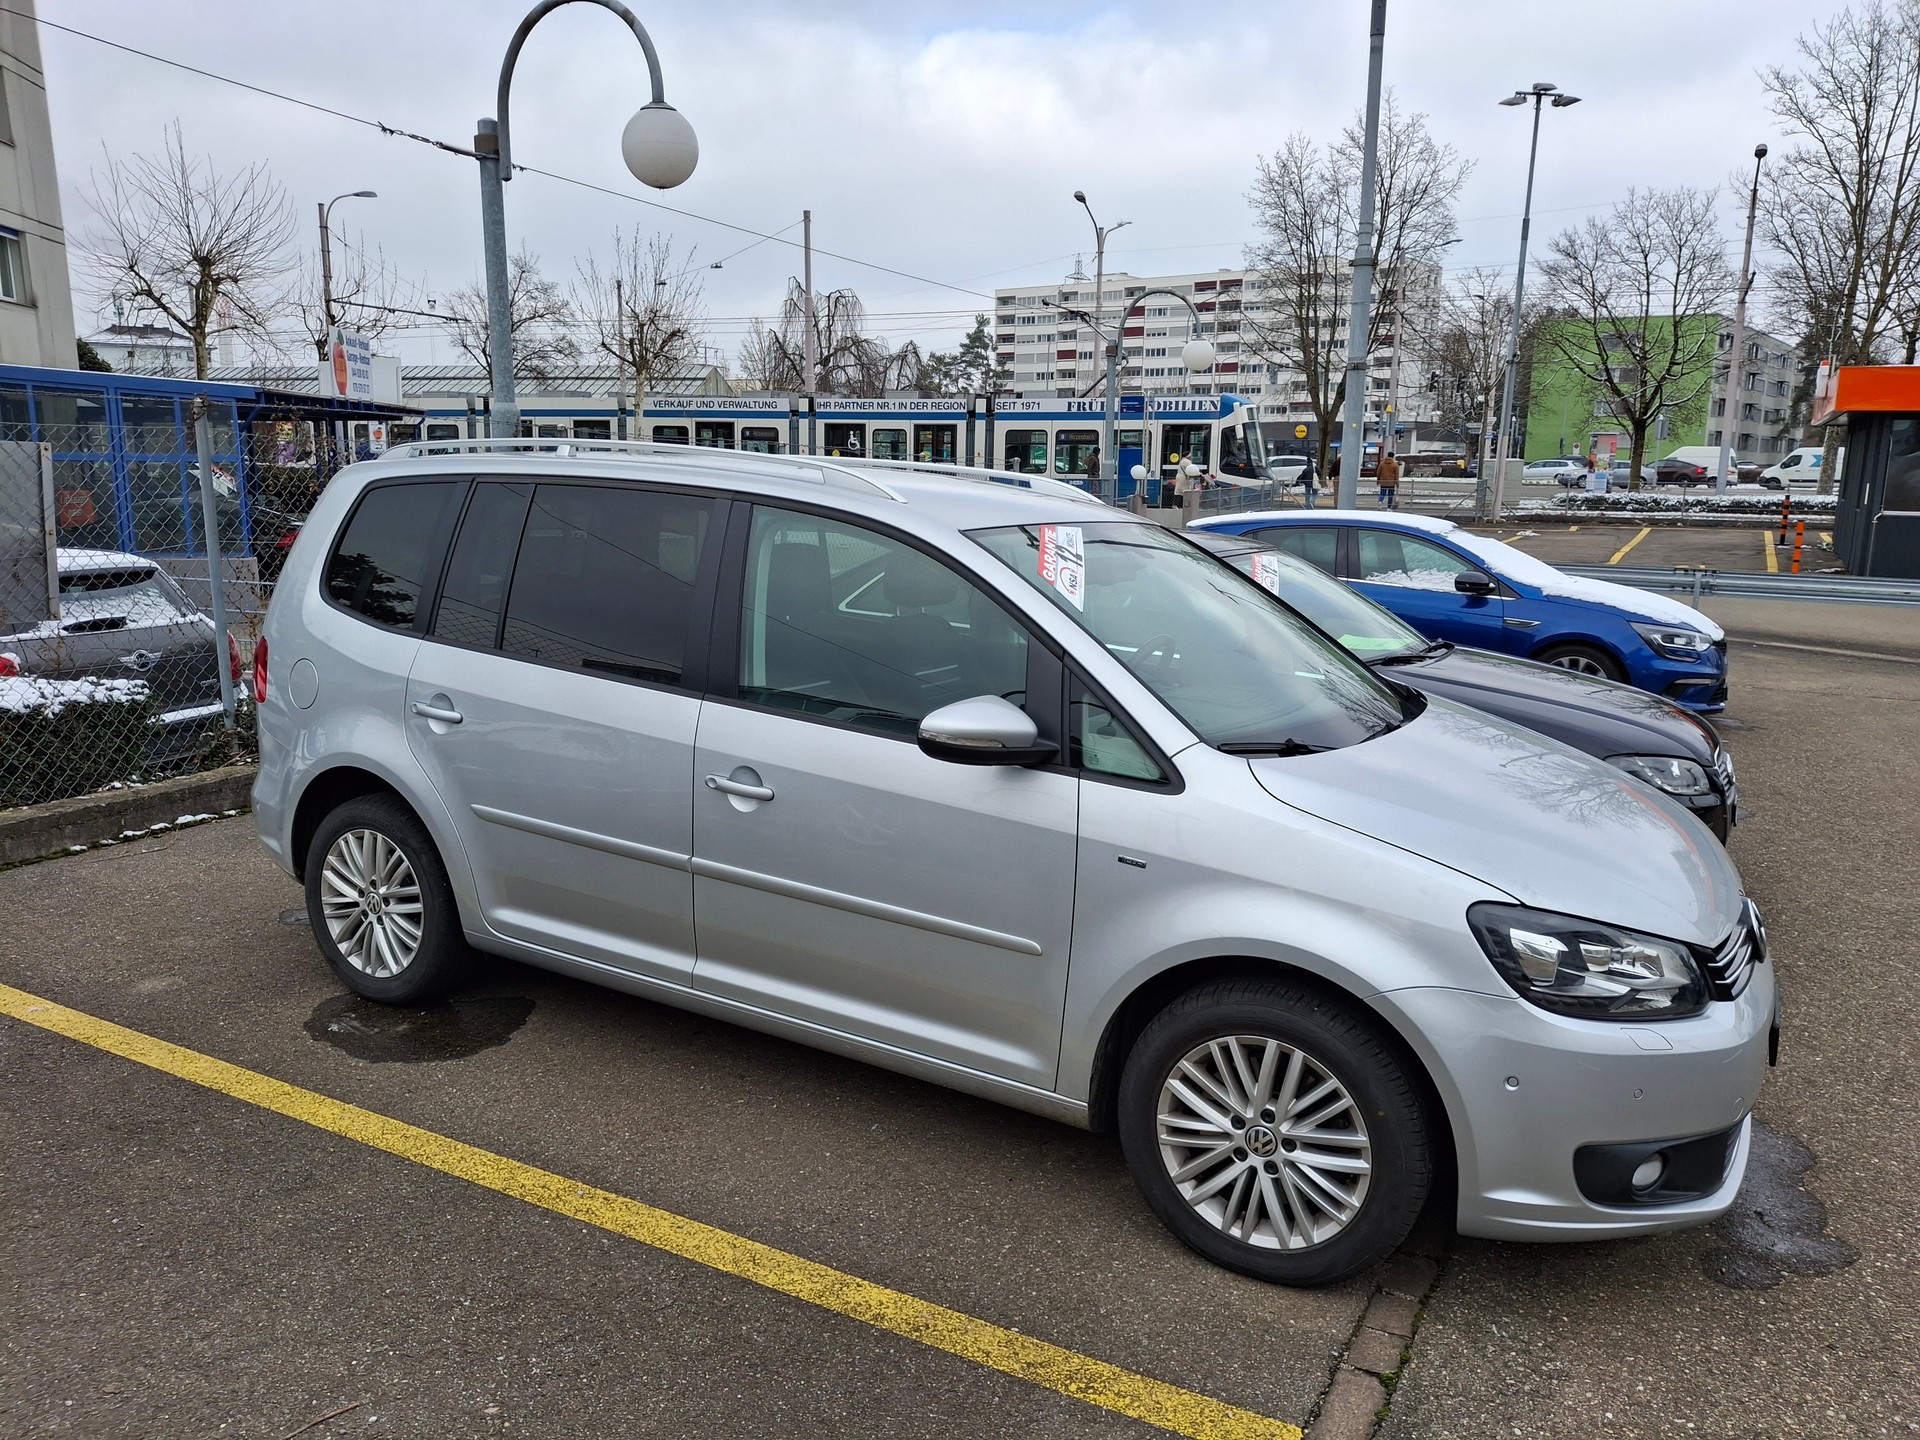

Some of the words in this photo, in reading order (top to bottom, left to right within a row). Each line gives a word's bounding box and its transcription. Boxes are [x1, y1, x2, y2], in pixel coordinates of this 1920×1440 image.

[653, 400, 693, 409] VERKAUF
[696, 400, 715, 409] UND
[716, 400, 778, 410] VERWALTUNG
[816, 401, 832, 410] IHR
[833, 401, 874, 410] PARTNER
[898, 401, 908, 410] IN
[910, 401, 928, 410] DER
[930, 401, 966, 411] REGION
[995, 401, 1017, 410] SEIT
[1020, 401, 1041, 410] 1971
[1043, 527, 1056, 582] GARANTIE
[1055, 545, 1083, 568] 12
[1068, 573, 1077, 591] NSA
